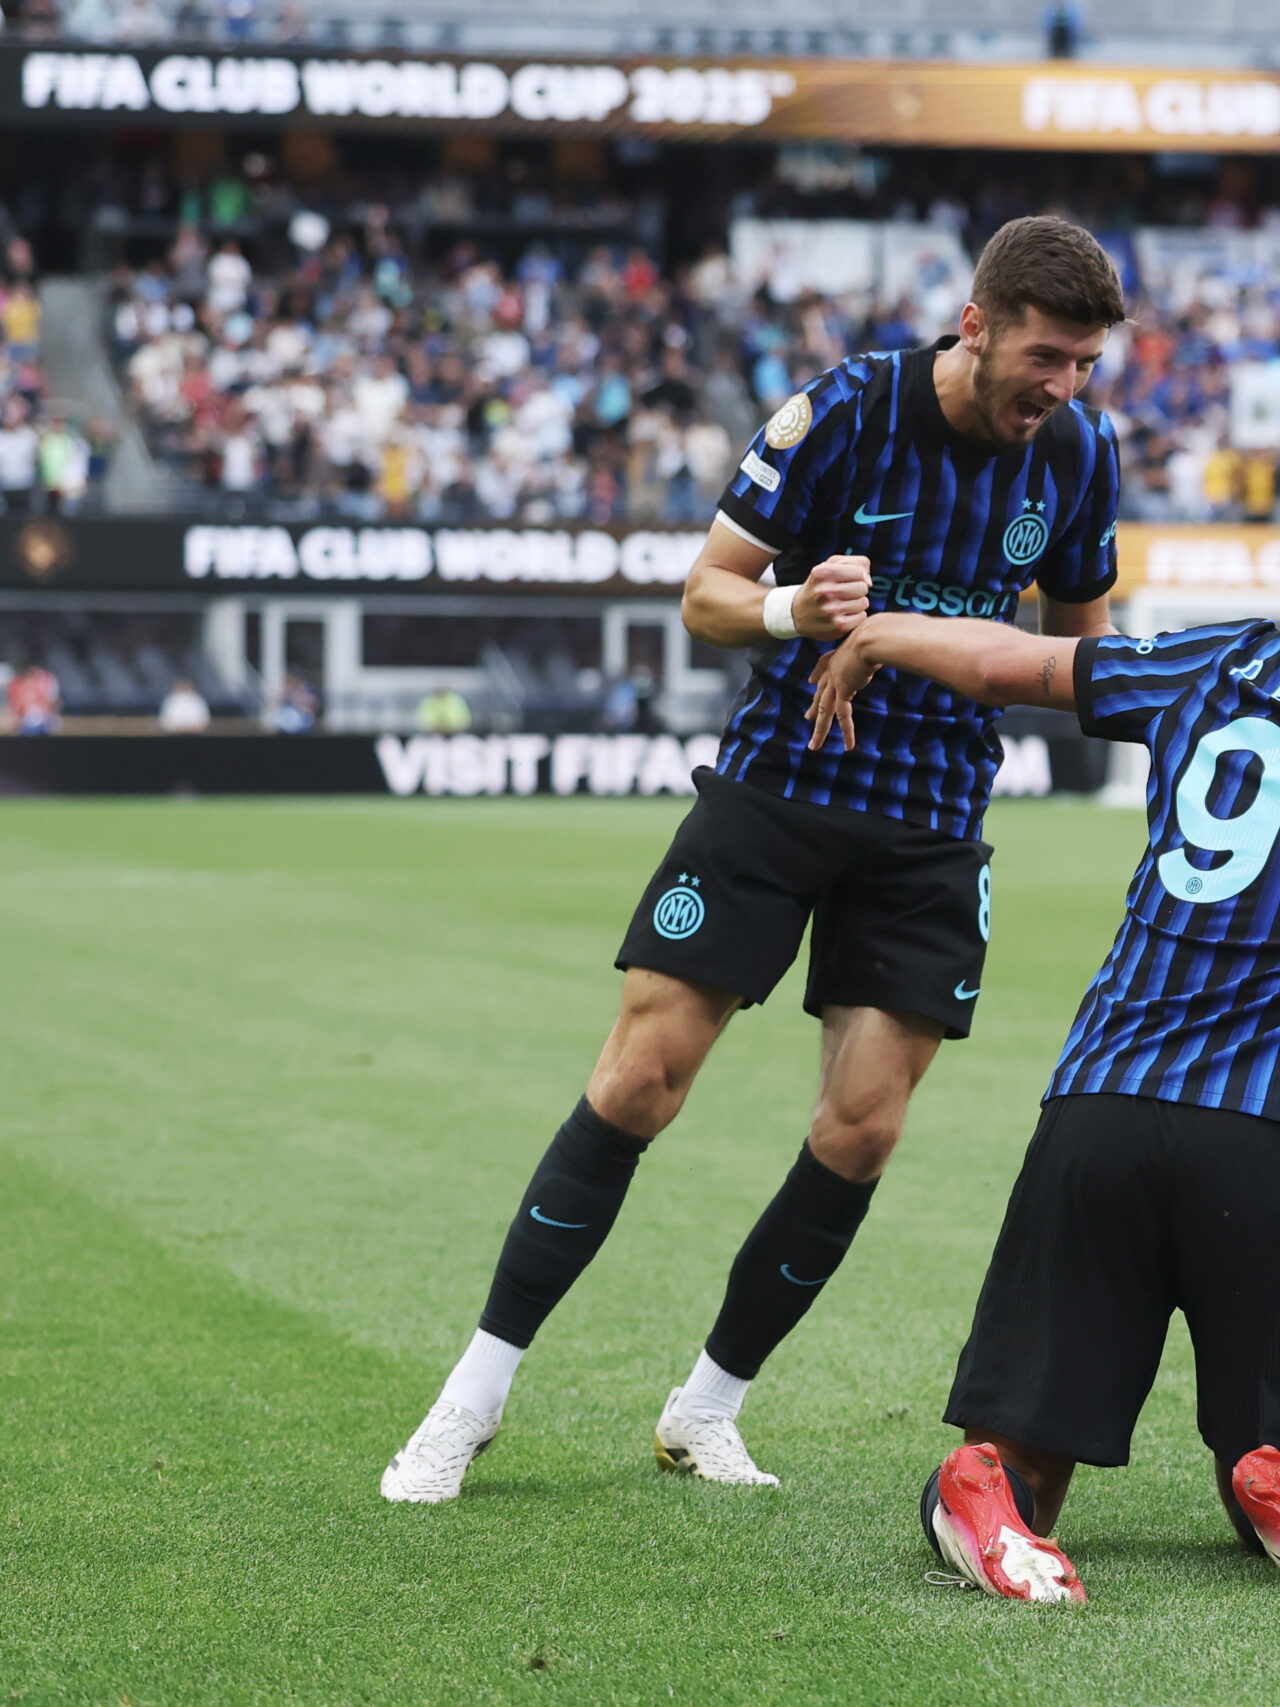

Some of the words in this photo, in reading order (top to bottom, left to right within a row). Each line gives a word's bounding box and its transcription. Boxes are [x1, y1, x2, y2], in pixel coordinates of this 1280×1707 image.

[22, 52, 148, 109] FIFA
[150, 56, 300, 113] CLUB
[302, 60, 508, 118] WORLD
[509, 64, 628, 121] CUP
[1022, 78, 1140, 132] FIFA
[185, 525, 298, 579] FIFA
[300, 527, 433, 581] CLUB
[434, 529, 618, 584] WORLD
[1145, 538, 1253, 586] FIFA
[866, 573, 1011, 617] etsson
[374, 733, 549, 797] VISIT
